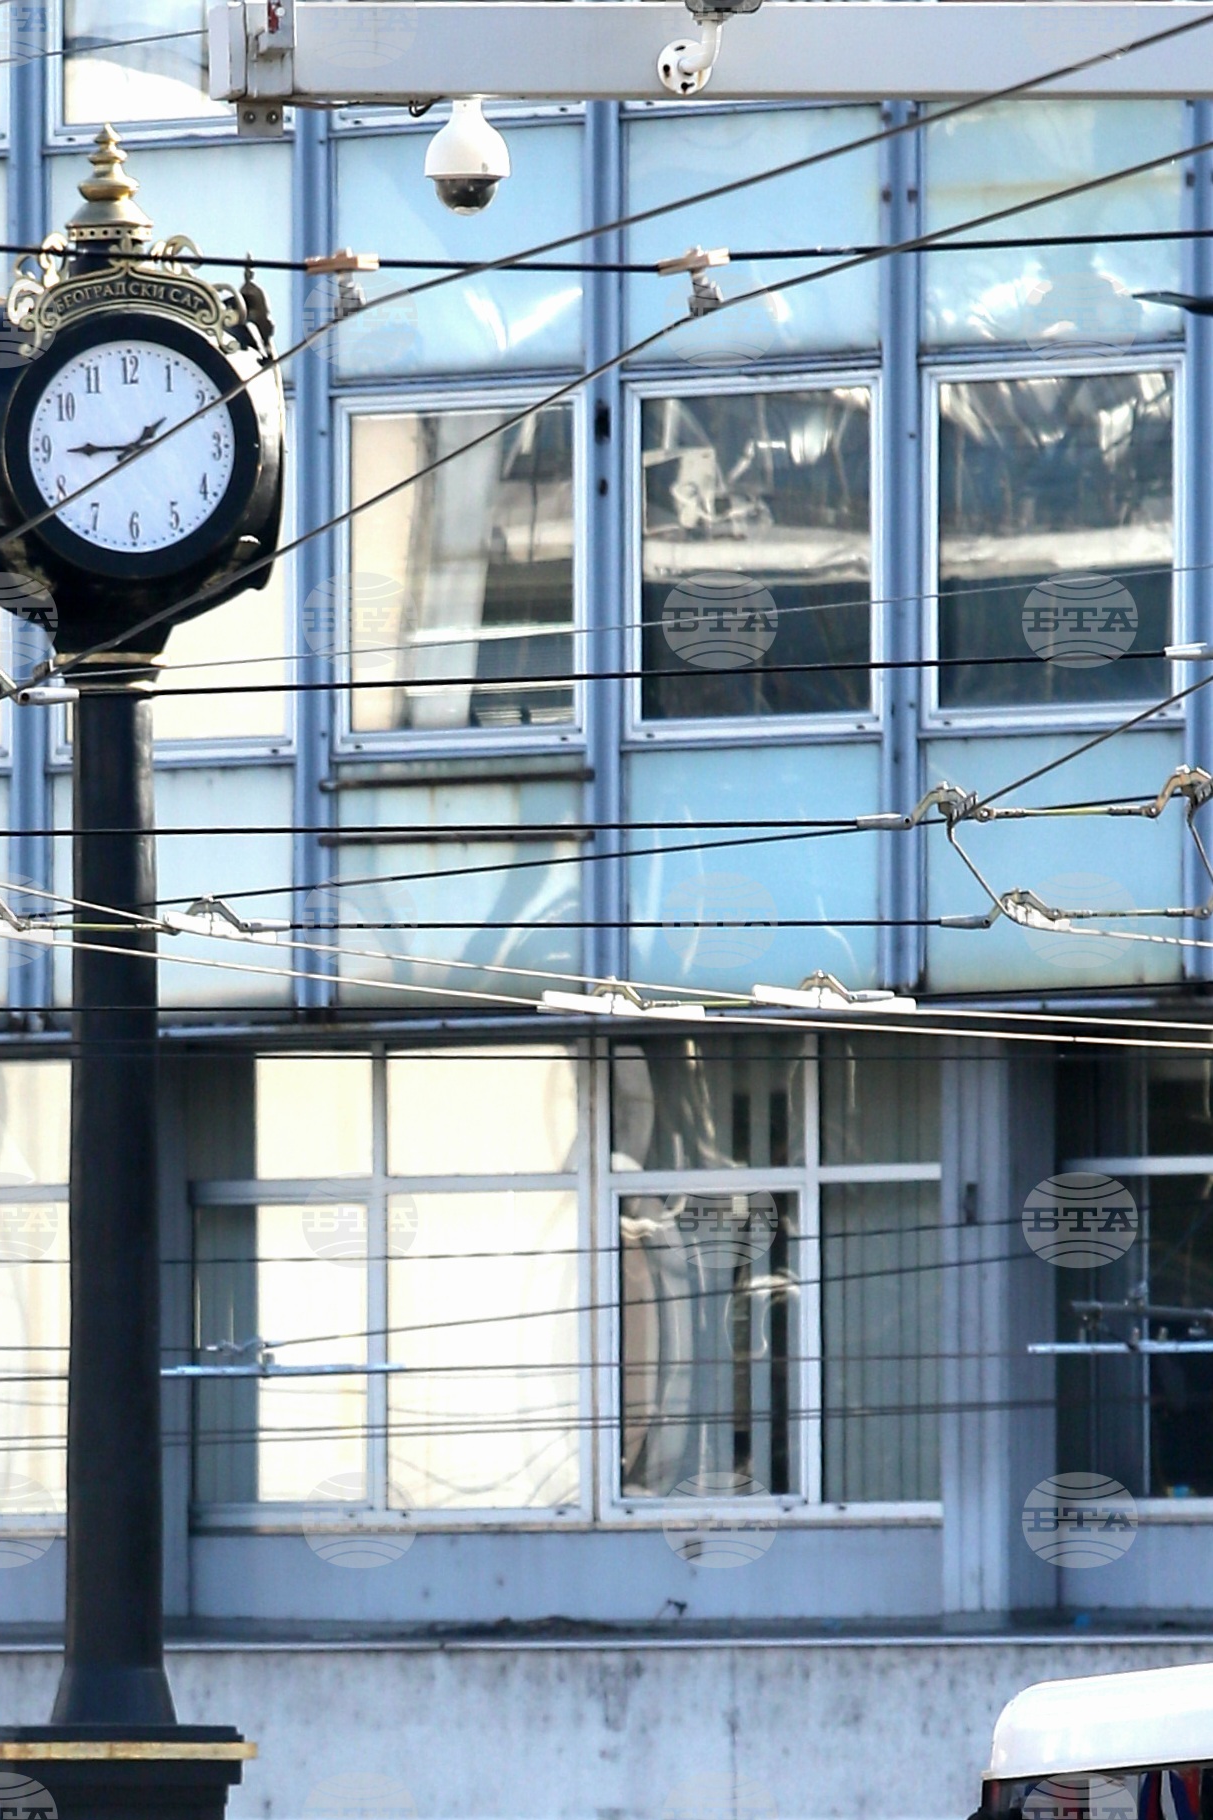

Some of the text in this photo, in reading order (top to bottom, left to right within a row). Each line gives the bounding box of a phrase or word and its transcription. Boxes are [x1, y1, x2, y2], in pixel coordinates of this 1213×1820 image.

[55, 281, 205, 313] БЕОГРАДСКИ САТ
[86, 365, 102, 394] 11
[121, 356, 140, 385] 12
[164, 363, 174, 393] 1
[57, 392, 76, 422] 10
[41, 435, 52, 463] 9
[212, 432, 223, 461] 3
[56, 475, 68, 503] 8
[199, 473, 210, 501] 4
[90, 502, 100, 532] 7
[129, 511, 140, 540] 6
[169, 501, 180, 531] 5
